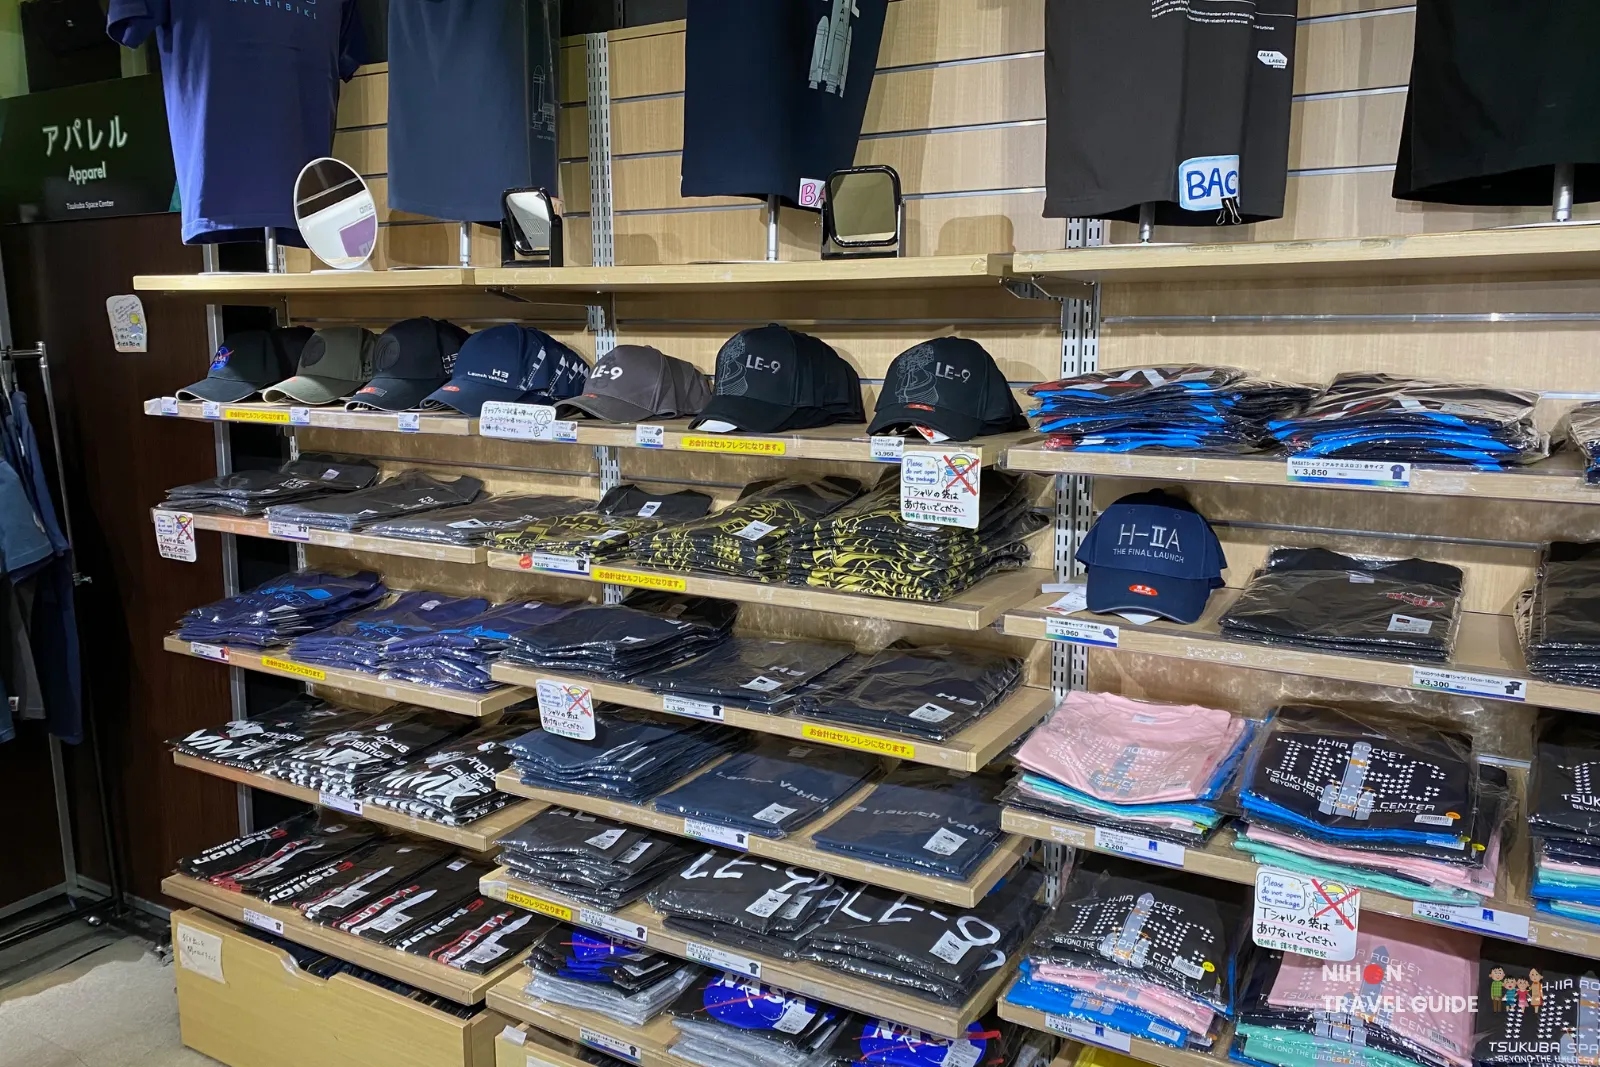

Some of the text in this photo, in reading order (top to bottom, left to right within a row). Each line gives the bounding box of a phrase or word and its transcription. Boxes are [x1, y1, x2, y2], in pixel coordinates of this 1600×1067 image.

[42, 115, 128, 157] アパレル
[68, 160, 106, 185] Apparel
[85, 201, 98, 210] Space
[98, 200, 114, 208] Center
[746, 355, 781, 374] LE-9
[467, 371, 508, 383] Launch Vehicle
[492, 368, 509, 378] H3
[590, 364, 623, 381] LE-9
[936, 362, 971, 383] LE-9
[689, 439, 782, 452] お会計はセルフレジになります。
[906, 459, 923, 467] Please
[916, 476, 936, 485] package
[1303, 469, 1327, 477] 3,850
[904, 499, 965, 514] あけないでください
[1127, 549, 1152, 558] FINAL
[1154, 550, 1184, 564] LAUNCH
[598, 571, 683, 588] お会計はセルフレジになります。
[1059, 629, 1079, 637] 3,960
[1420, 679, 1454, 688] ¥3,300
[809, 728, 911, 755] お会計はセルフレジになります。
[1317, 738, 1406, 760] H-IIA ROCKET
[1123, 746, 1168, 758] ROCKET
[1264, 767, 1436, 811] TSUKUBA SPACE CENTER
[1269, 776, 1302, 794] BEYOND
[1302, 788, 1316, 799] THE
[1317, 796, 1352, 810] WILDEST
[1354, 806, 1382, 815] DREAM
[1394, 807, 1422, 815] SPACE
[192, 828, 288, 865] Epsilon
[202, 837, 240, 855] Vehicle
[1105, 842, 1124, 851] 2,200
[268, 872, 307, 892] Vehicle
[1263, 876, 1283, 888] Please
[1271, 889, 1282, 897] not
[1286, 893, 1301, 901] open
[1138, 897, 1185, 915] ROCKET
[1261, 896, 1300, 911] the package
[1259, 906, 1330, 932] Tシャツの袋は
[1426, 910, 1450, 920] 2,200
[1256, 921, 1337, 947] あけないでください
[1054, 937, 1081, 949] BEYOND
[1081, 940, 1096, 950] THE
[1155, 963, 1163, 973] IN
[1164, 966, 1187, 981] SPACE
[1108, 937, 1150, 956] SPACE
[1152, 952, 1176, 968] CEN
[1055, 1024, 1072, 1033] 2,310
[1262, 1042, 1294, 1054] BEYOND
[1296, 1049, 1309, 1058] THE
[1312, 1054, 1347, 1064] WILDEST
[1489, 1041, 1561, 1053] TSUKUBA
[1499, 1055, 1535, 1064] BEYOND
[1535, 1055, 1551, 1063] THE
